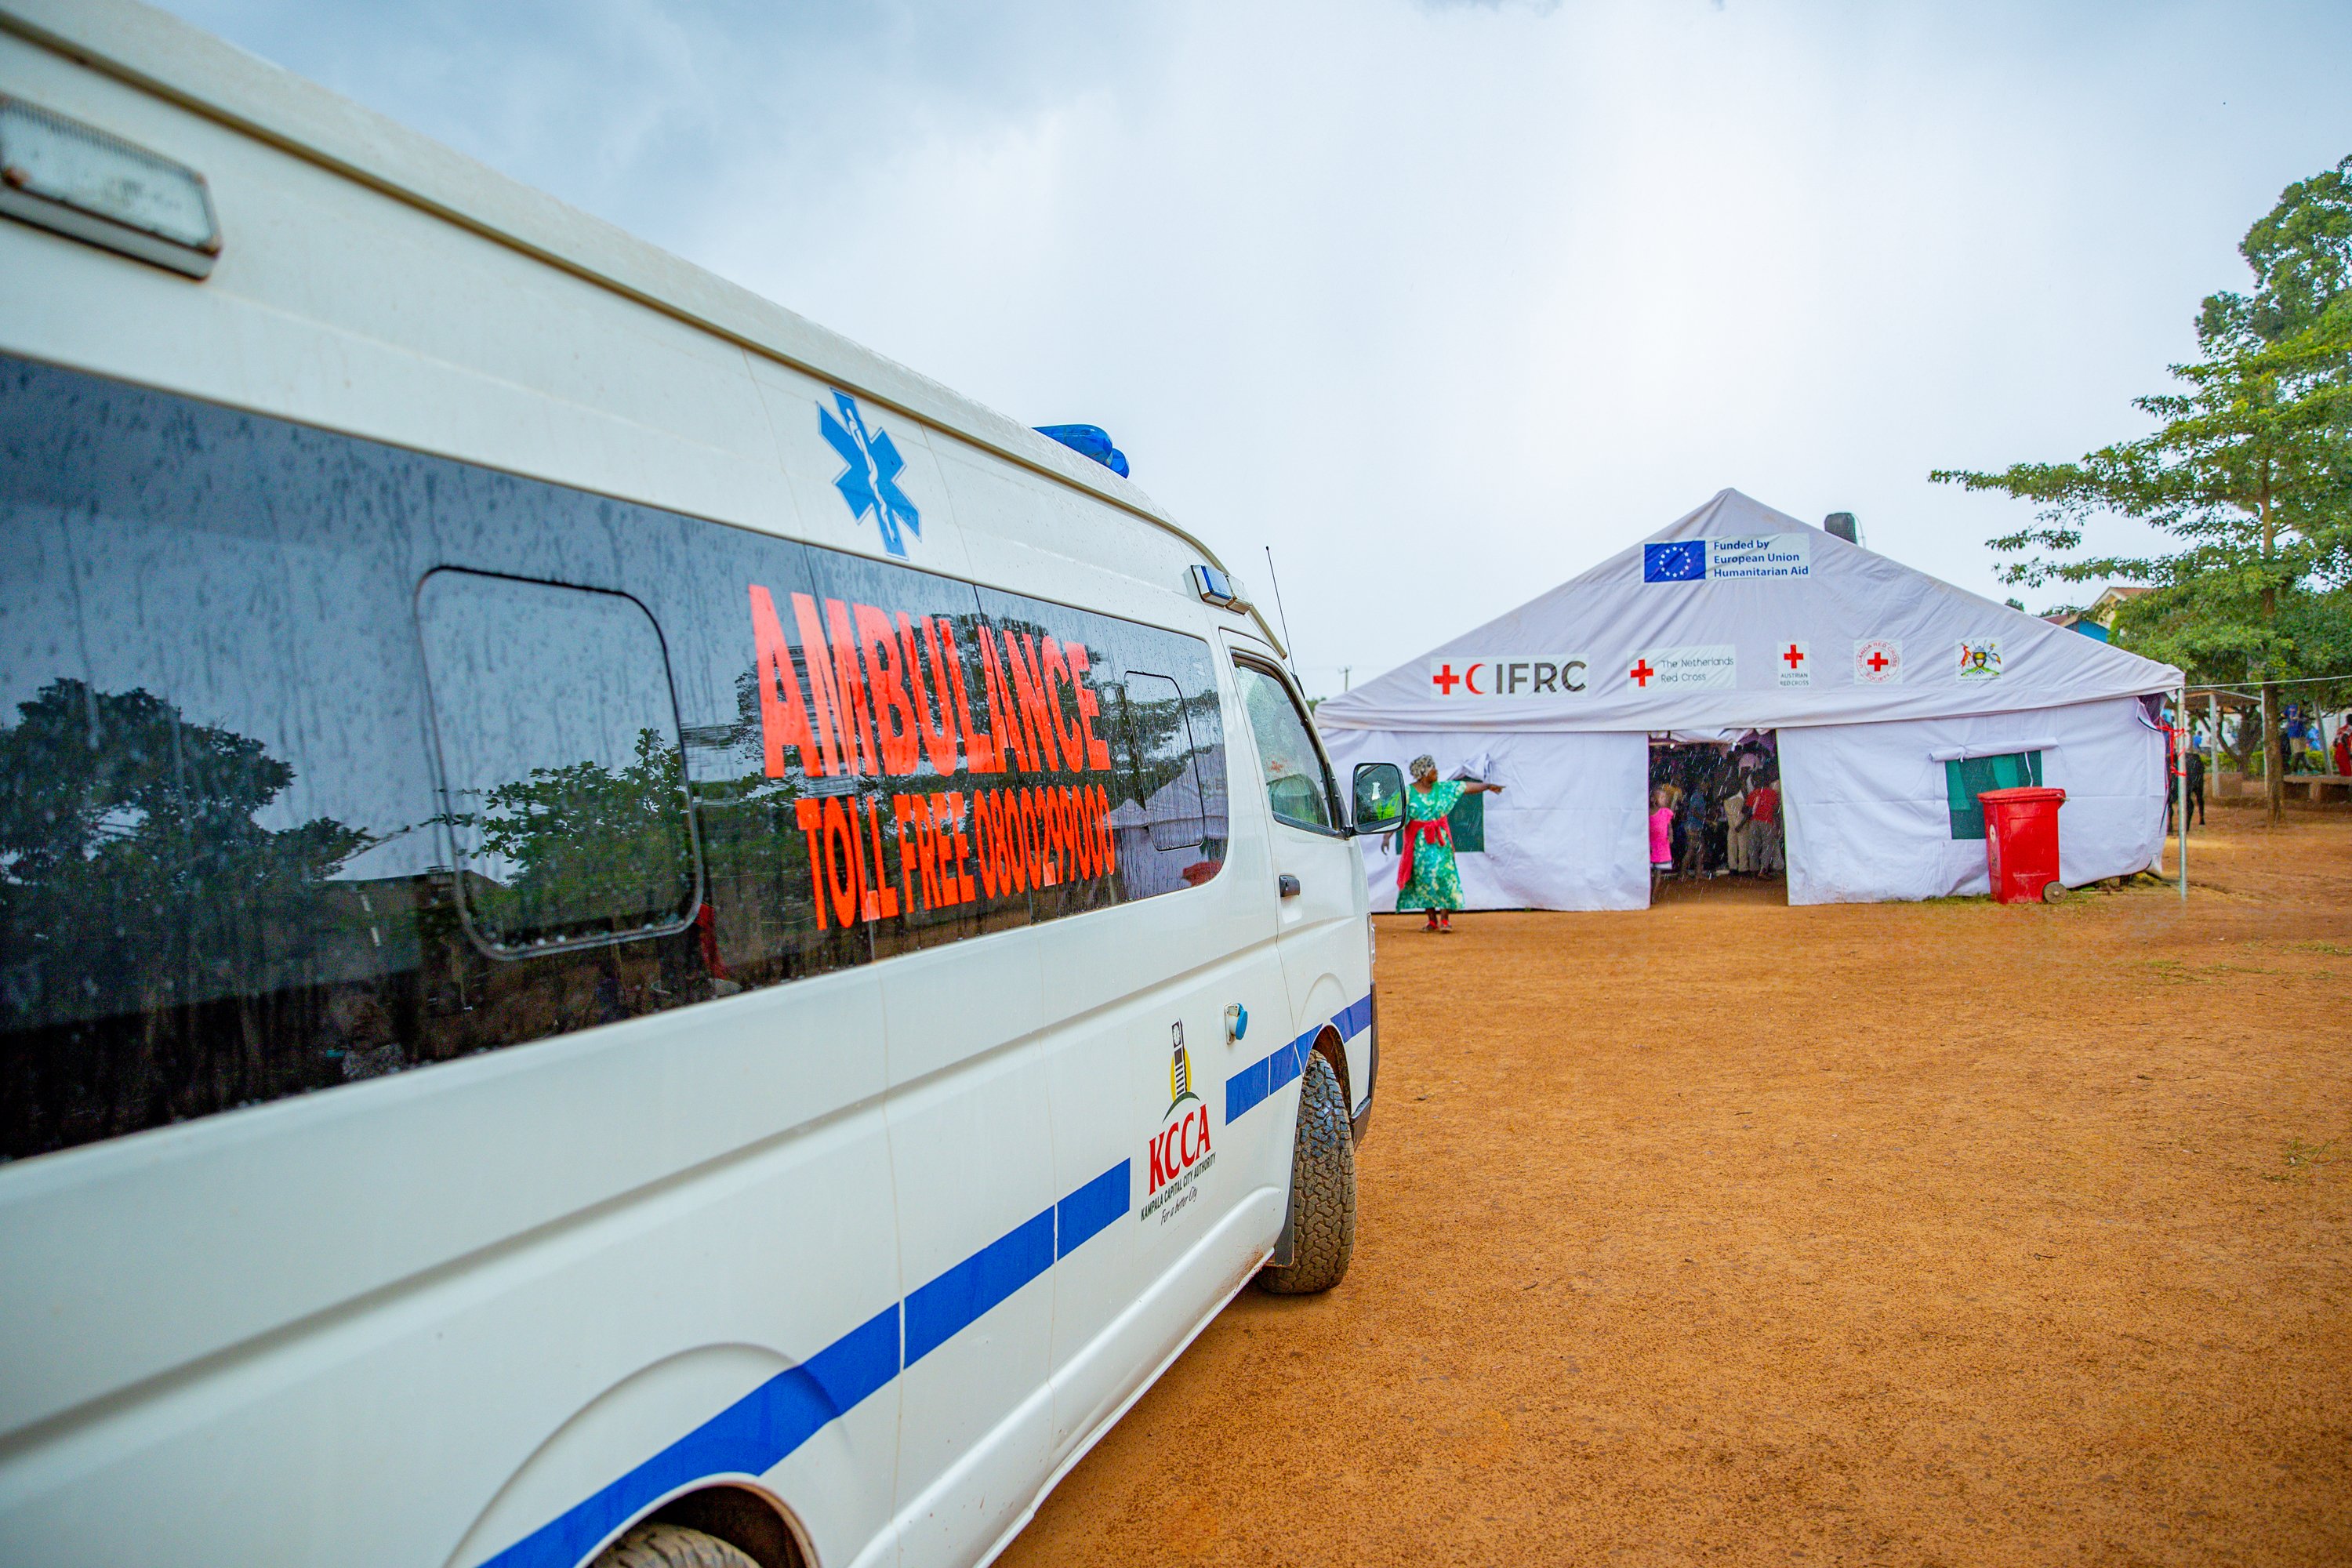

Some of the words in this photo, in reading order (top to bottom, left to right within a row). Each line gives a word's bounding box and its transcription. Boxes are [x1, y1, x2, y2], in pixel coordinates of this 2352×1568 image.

[1714, 539, 1754, 550] Funded
[1756, 539, 1769, 550] by
[1714, 555, 1765, 564] European
[1767, 553, 1800, 562] Union
[1714, 567, 1788, 577] Humanitarian
[1791, 565, 1809, 575] Aid
[1495, 661, 1588, 695] IFRC
[1661, 659, 1679, 669] The
[1681, 656, 1734, 667] Netherlands
[1661, 673, 1679, 683] Red
[1681, 673, 1707, 682] Cross
[748, 583, 1112, 778] AMBULANCE
[794, 795, 900, 931] TOLL
[892, 791, 977, 914] FREE
[974, 783, 1116, 900] 0800299000
[1149, 1104, 1211, 1196] KCCA
[1141, 1193, 1163, 1222] KAMPALA
[1164, 1178, 1182, 1203] CAPITAL
[1183, 1170, 1193, 1188] CITY
[1193, 1152, 1216, 1179] AUTHORITY
[1161, 1208, 1170, 1225] For
[1170, 1207, 1174, 1217] a
[1174, 1196, 1189, 1213] better
[1189, 1186, 1198, 1203] City
